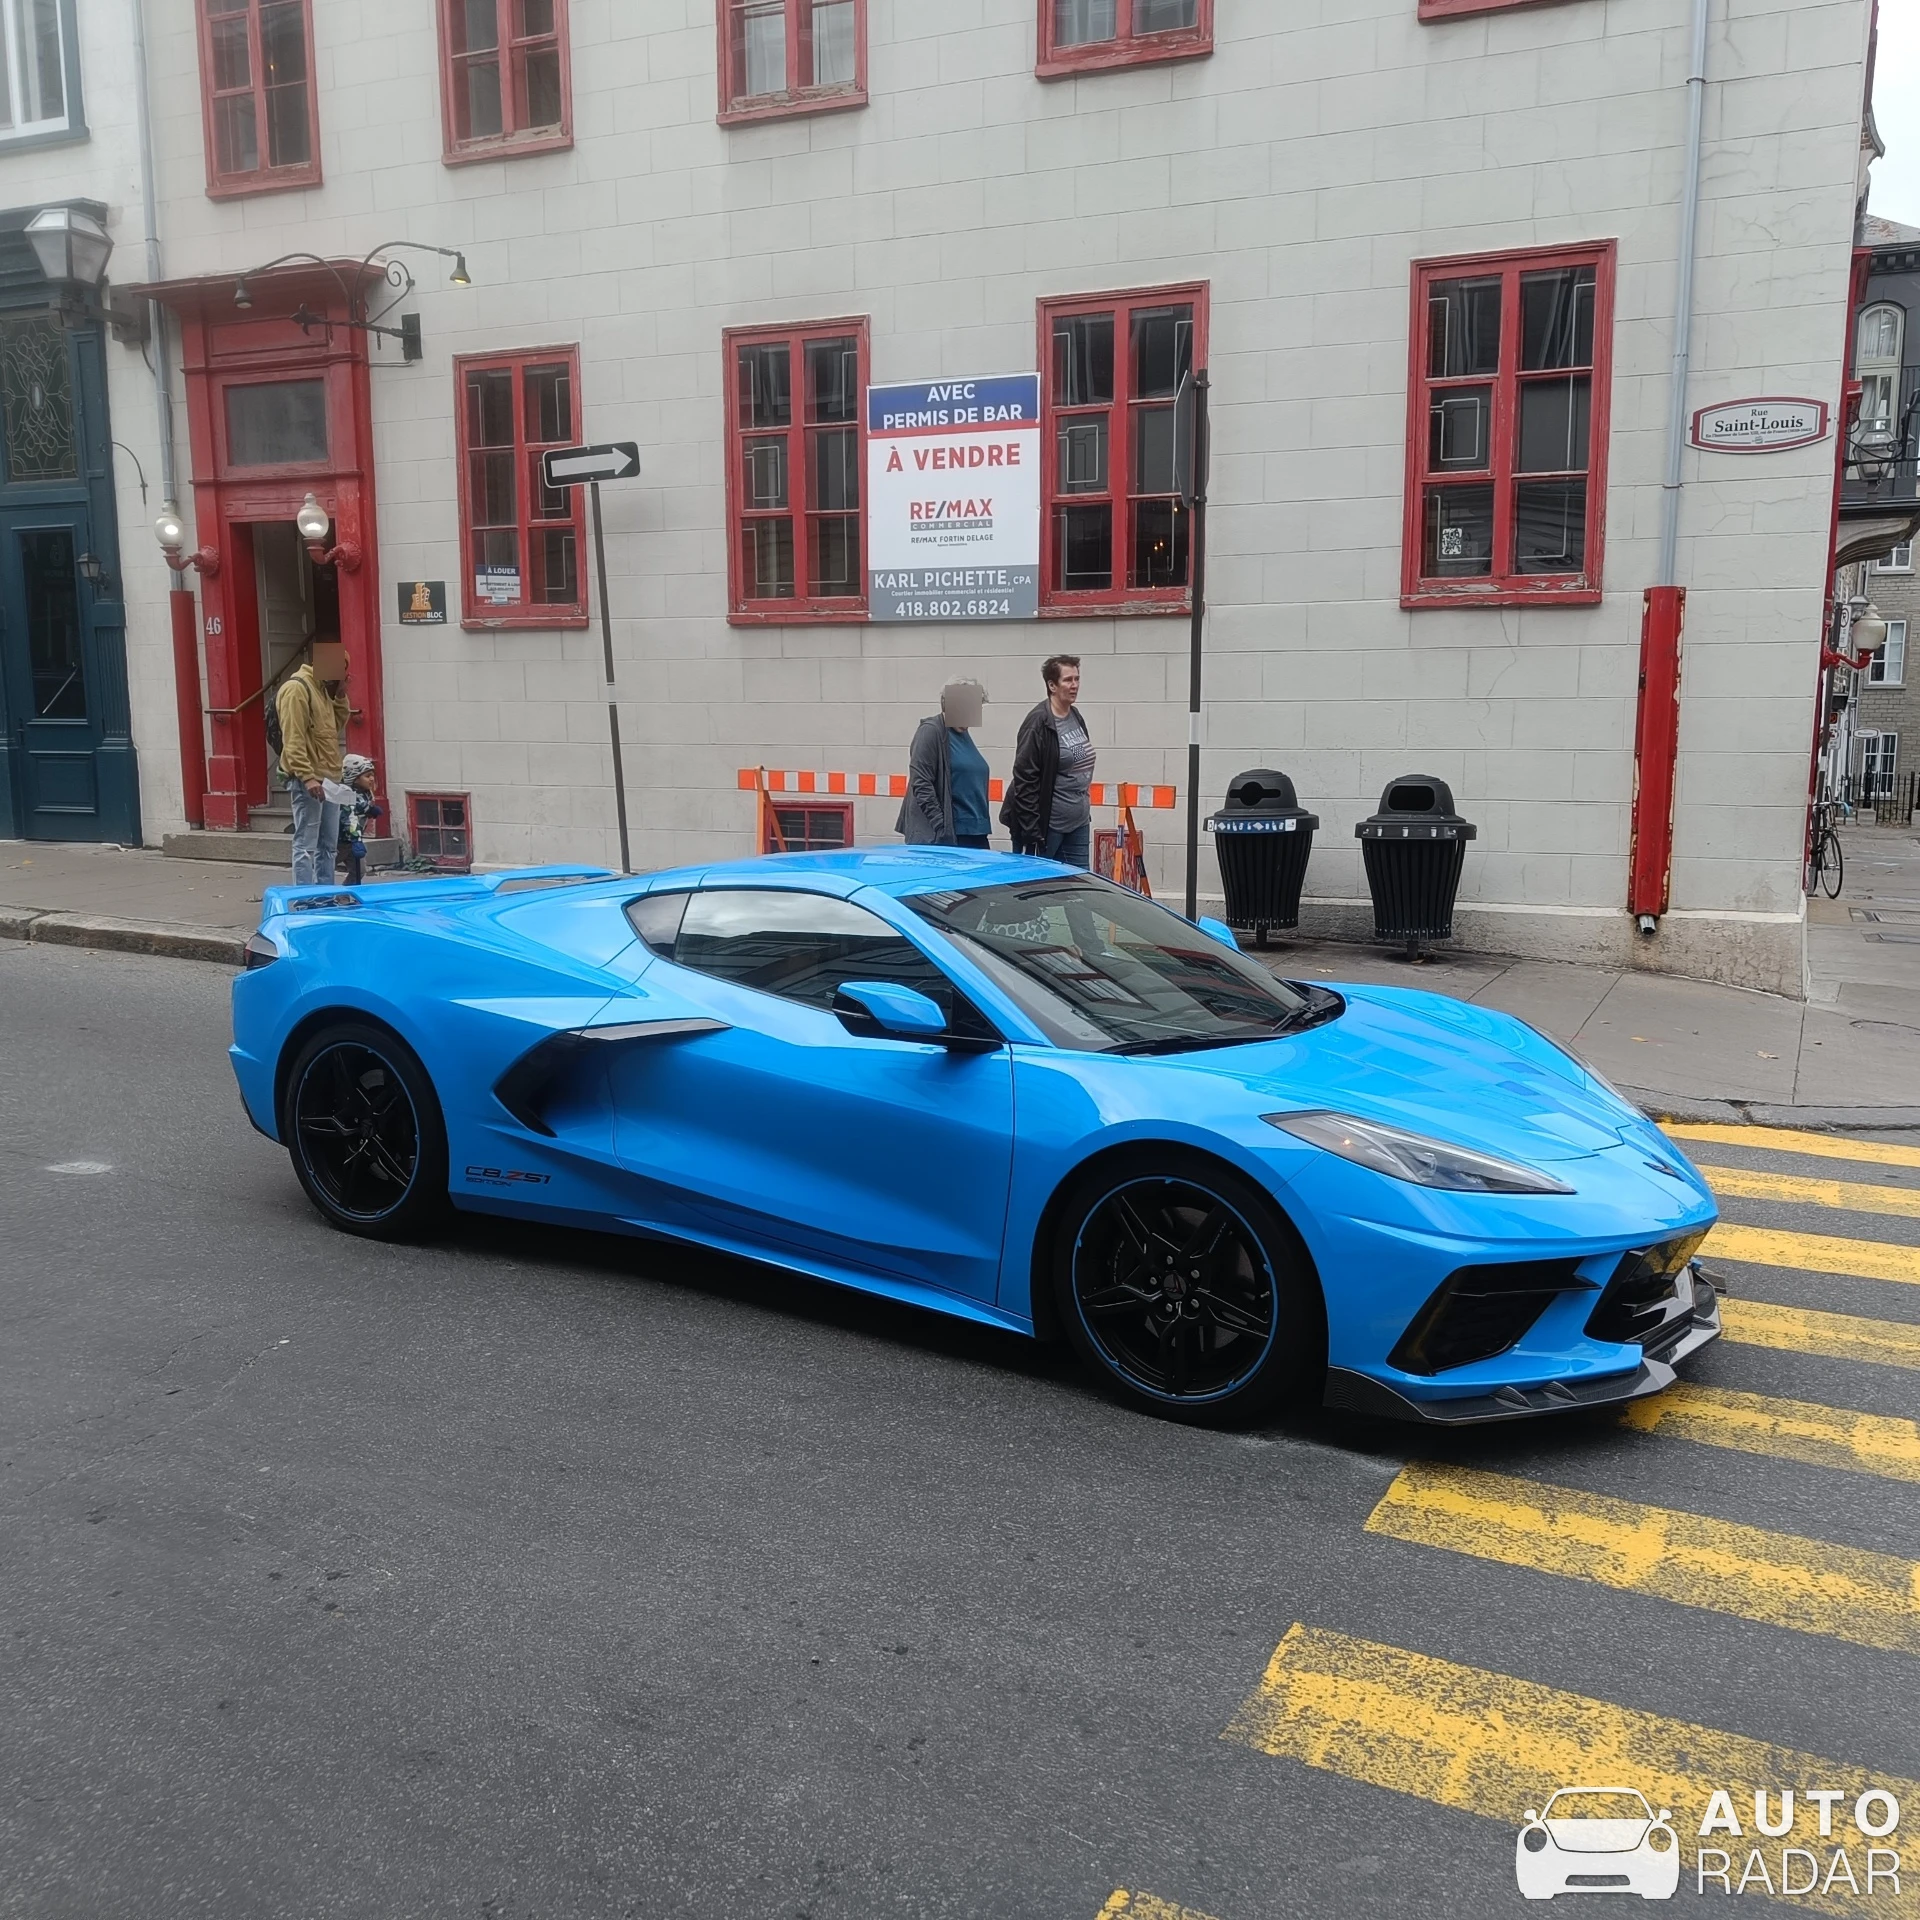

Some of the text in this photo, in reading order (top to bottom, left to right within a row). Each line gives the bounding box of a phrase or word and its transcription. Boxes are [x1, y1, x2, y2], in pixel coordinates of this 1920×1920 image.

[927, 383, 976, 403] AVEC
[883, 403, 1023, 430] PERMIS DE BAR
[1751, 408, 1769, 417] Rue
[1714, 415, 1804, 433] Saint-Louis
[886, 443, 1021, 473] À VENDRE
[910, 498, 993, 520] RE/MAX
[912, 520, 991, 530] COMMERCIAL
[910, 533, 994, 544] RE/MAX FORTIN DELAGE
[493, 567, 516, 575] LOUER
[874, 569, 1032, 589] KARL PICHETTE, CPA
[891, 589, 914, 597] Courtier
[914, 588, 943, 596] immobilier
[984, 586, 1015, 594] résidentiel
[402, 611, 444, 619] GESTIONBLOC
[895, 599, 1011, 617] 418.802.6824
[205, 616, 222, 635] 46
